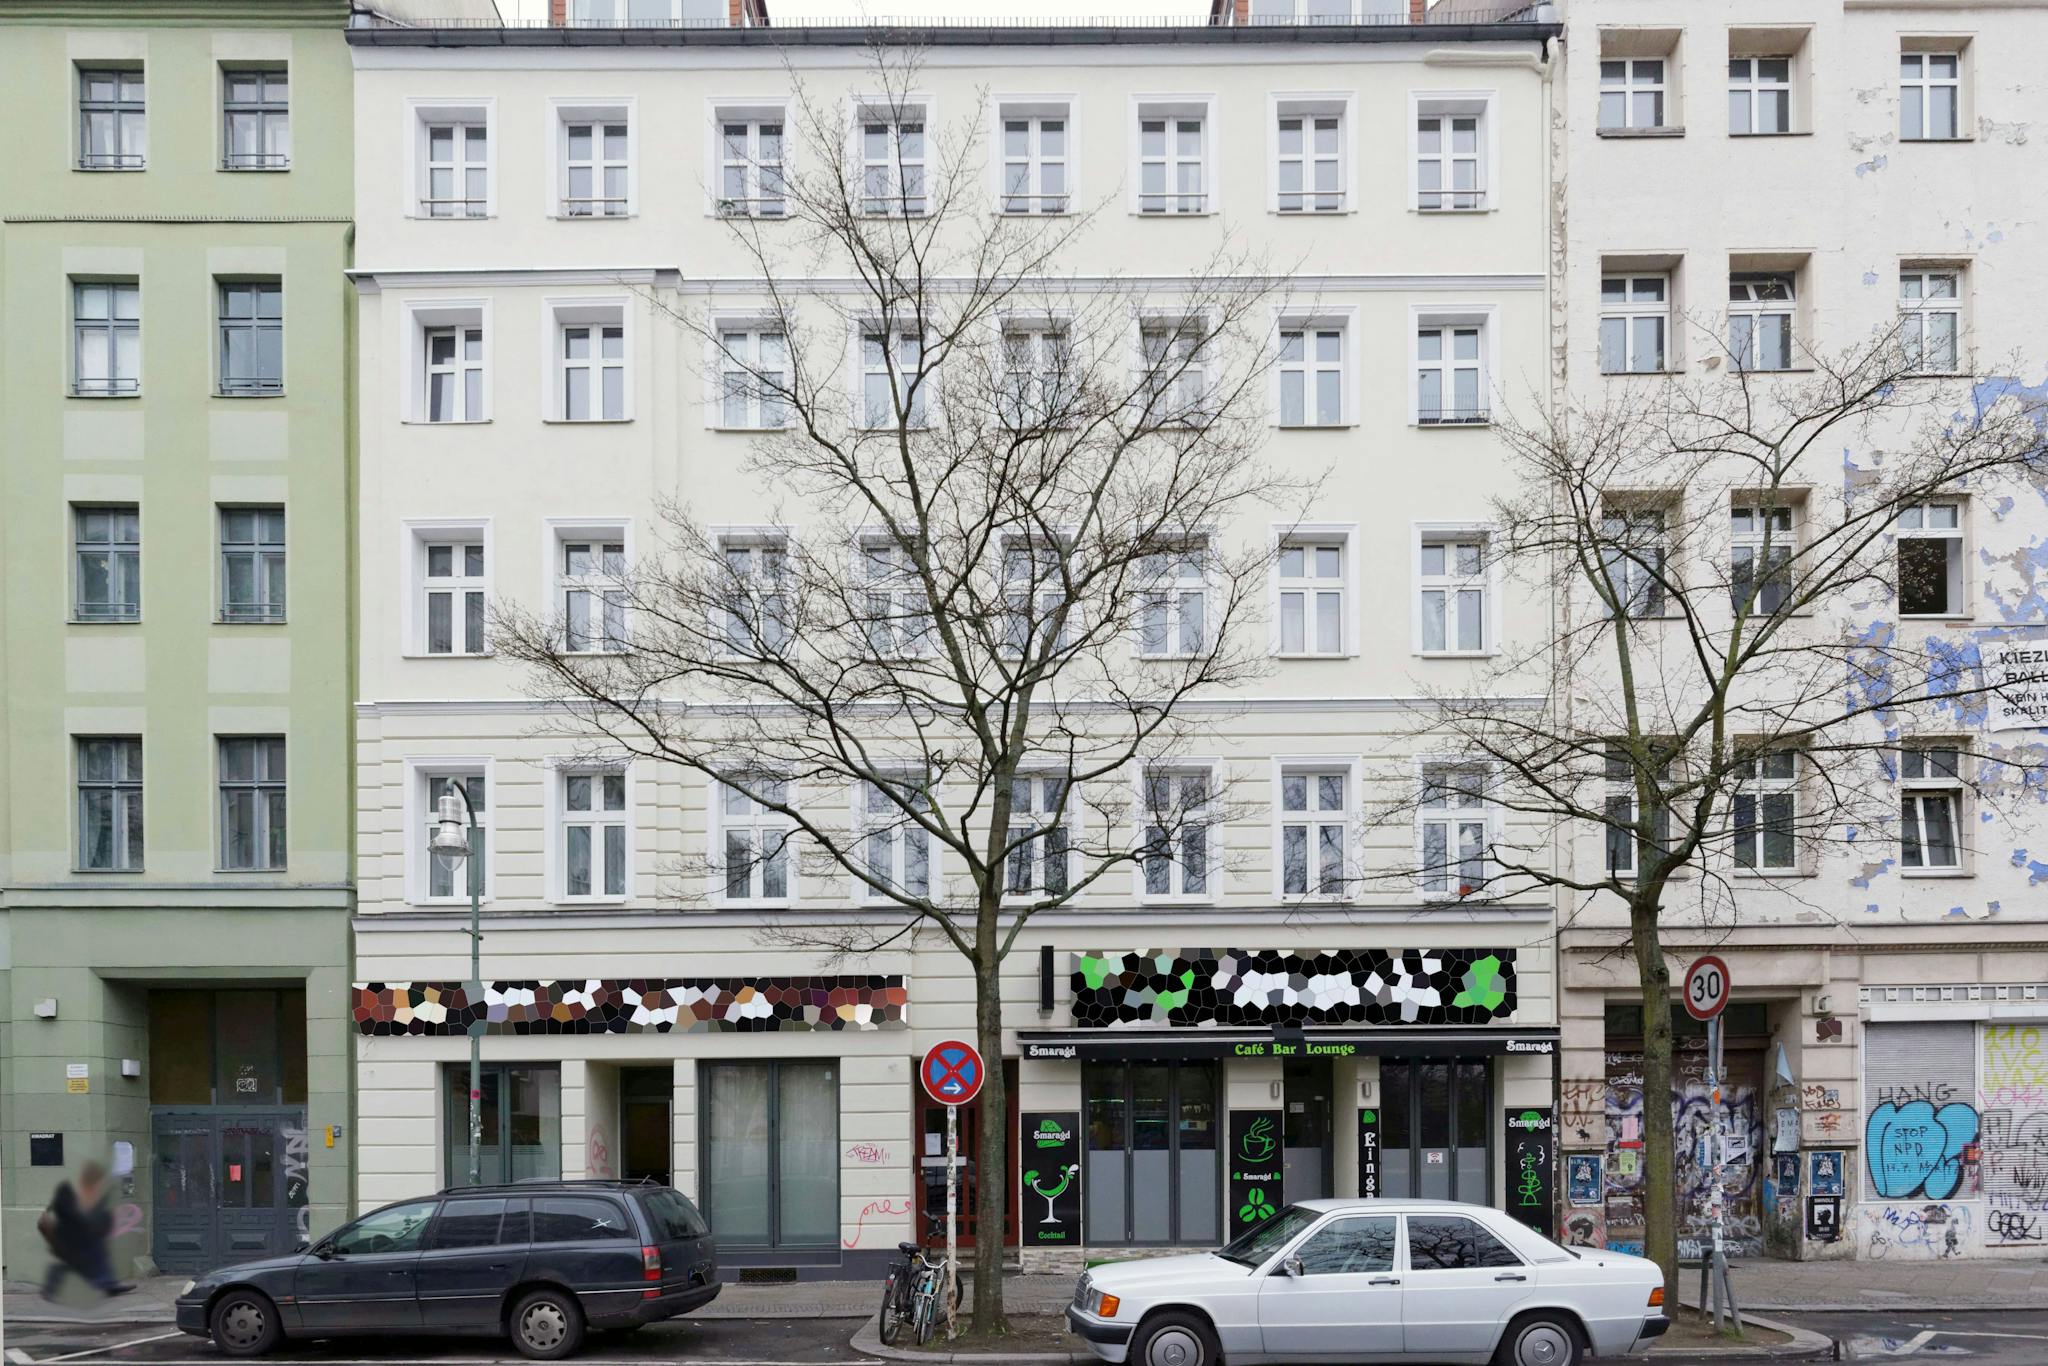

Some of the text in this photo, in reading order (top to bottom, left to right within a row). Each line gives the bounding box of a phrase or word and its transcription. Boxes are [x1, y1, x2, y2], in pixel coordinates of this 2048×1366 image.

[1693, 971, 1719, 1002] 30
[1029, 1044, 1076, 1059] Smaragd
[1234, 1042, 1355, 1056] Café Bar Lounge
[1506, 1040, 1553, 1053] Smaragd
[1508, 1117, 1551, 1129] Smaragd
[1033, 1130, 1071, 1141] Smaragd
[1894, 1126, 1928, 1141] STOP
[1893, 1142, 1923, 1158] NPD
[1243, 1172, 1272, 1182] Smaragd
[1038, 1231, 1066, 1239] Cocktail
